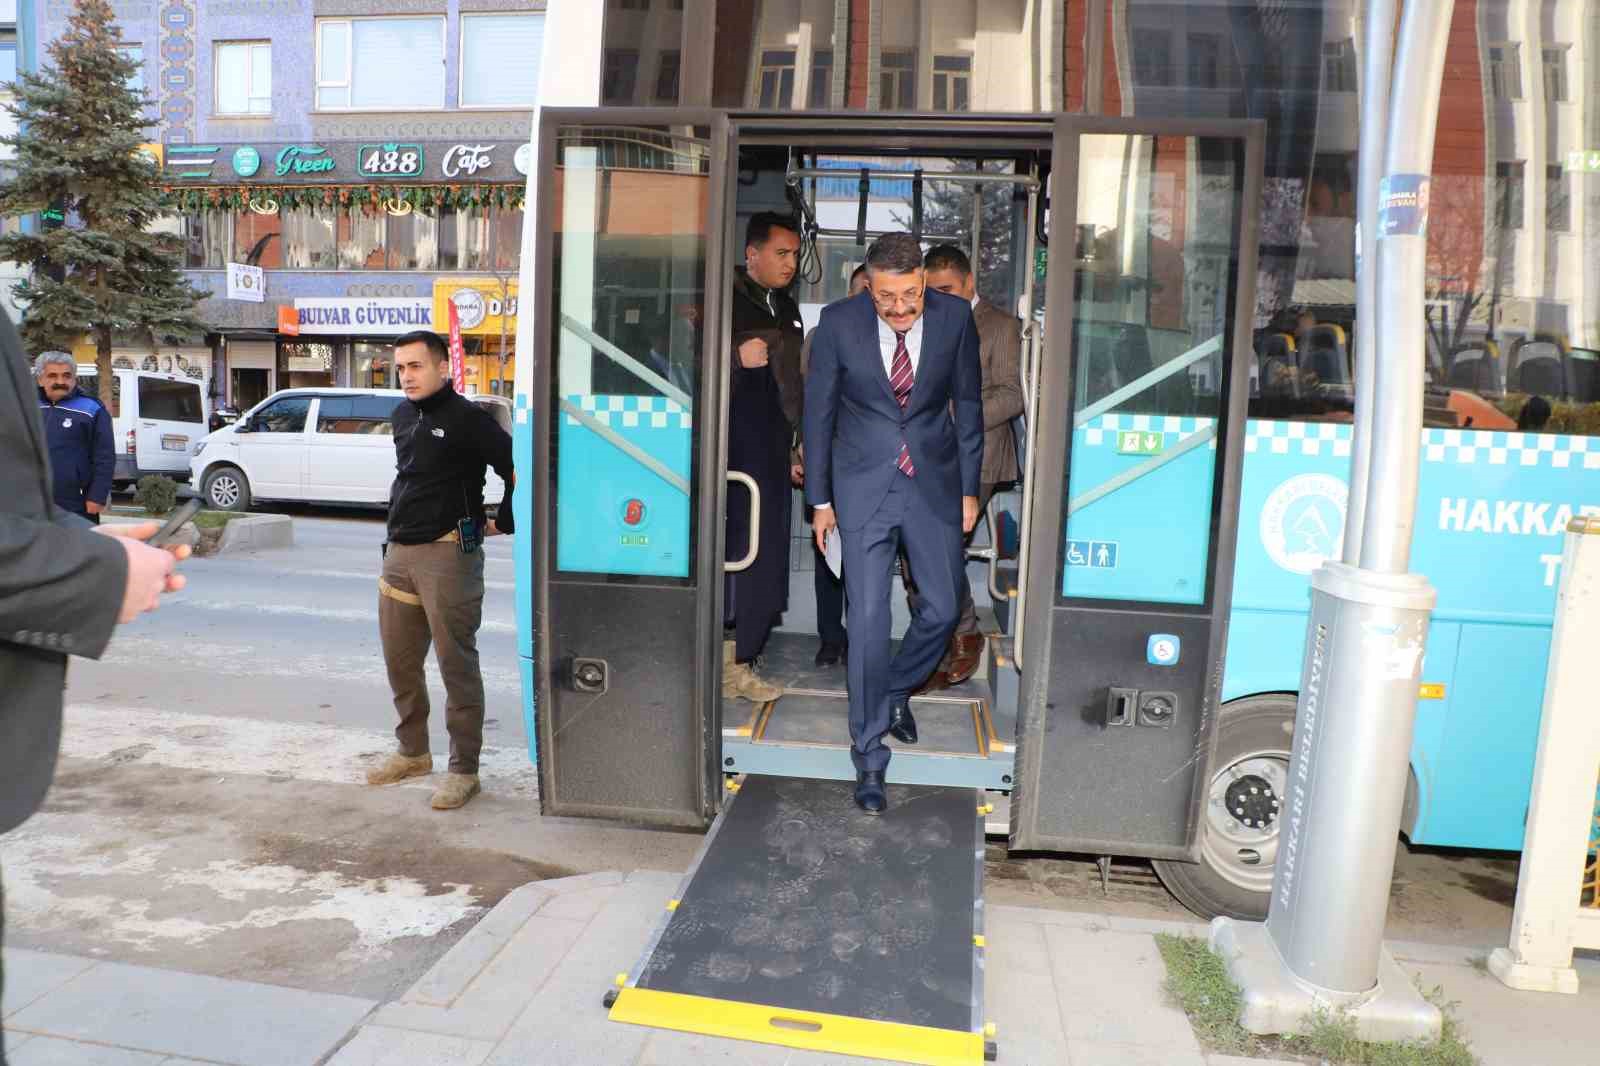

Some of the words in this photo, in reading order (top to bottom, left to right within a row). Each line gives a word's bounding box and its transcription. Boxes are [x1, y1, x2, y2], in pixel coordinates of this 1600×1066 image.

[275, 143, 337, 177] Green
[441, 144, 496, 178] Cafe
[298, 307, 350, 325] BULVAR
[356, 302, 432, 326] GÜVENLİK
